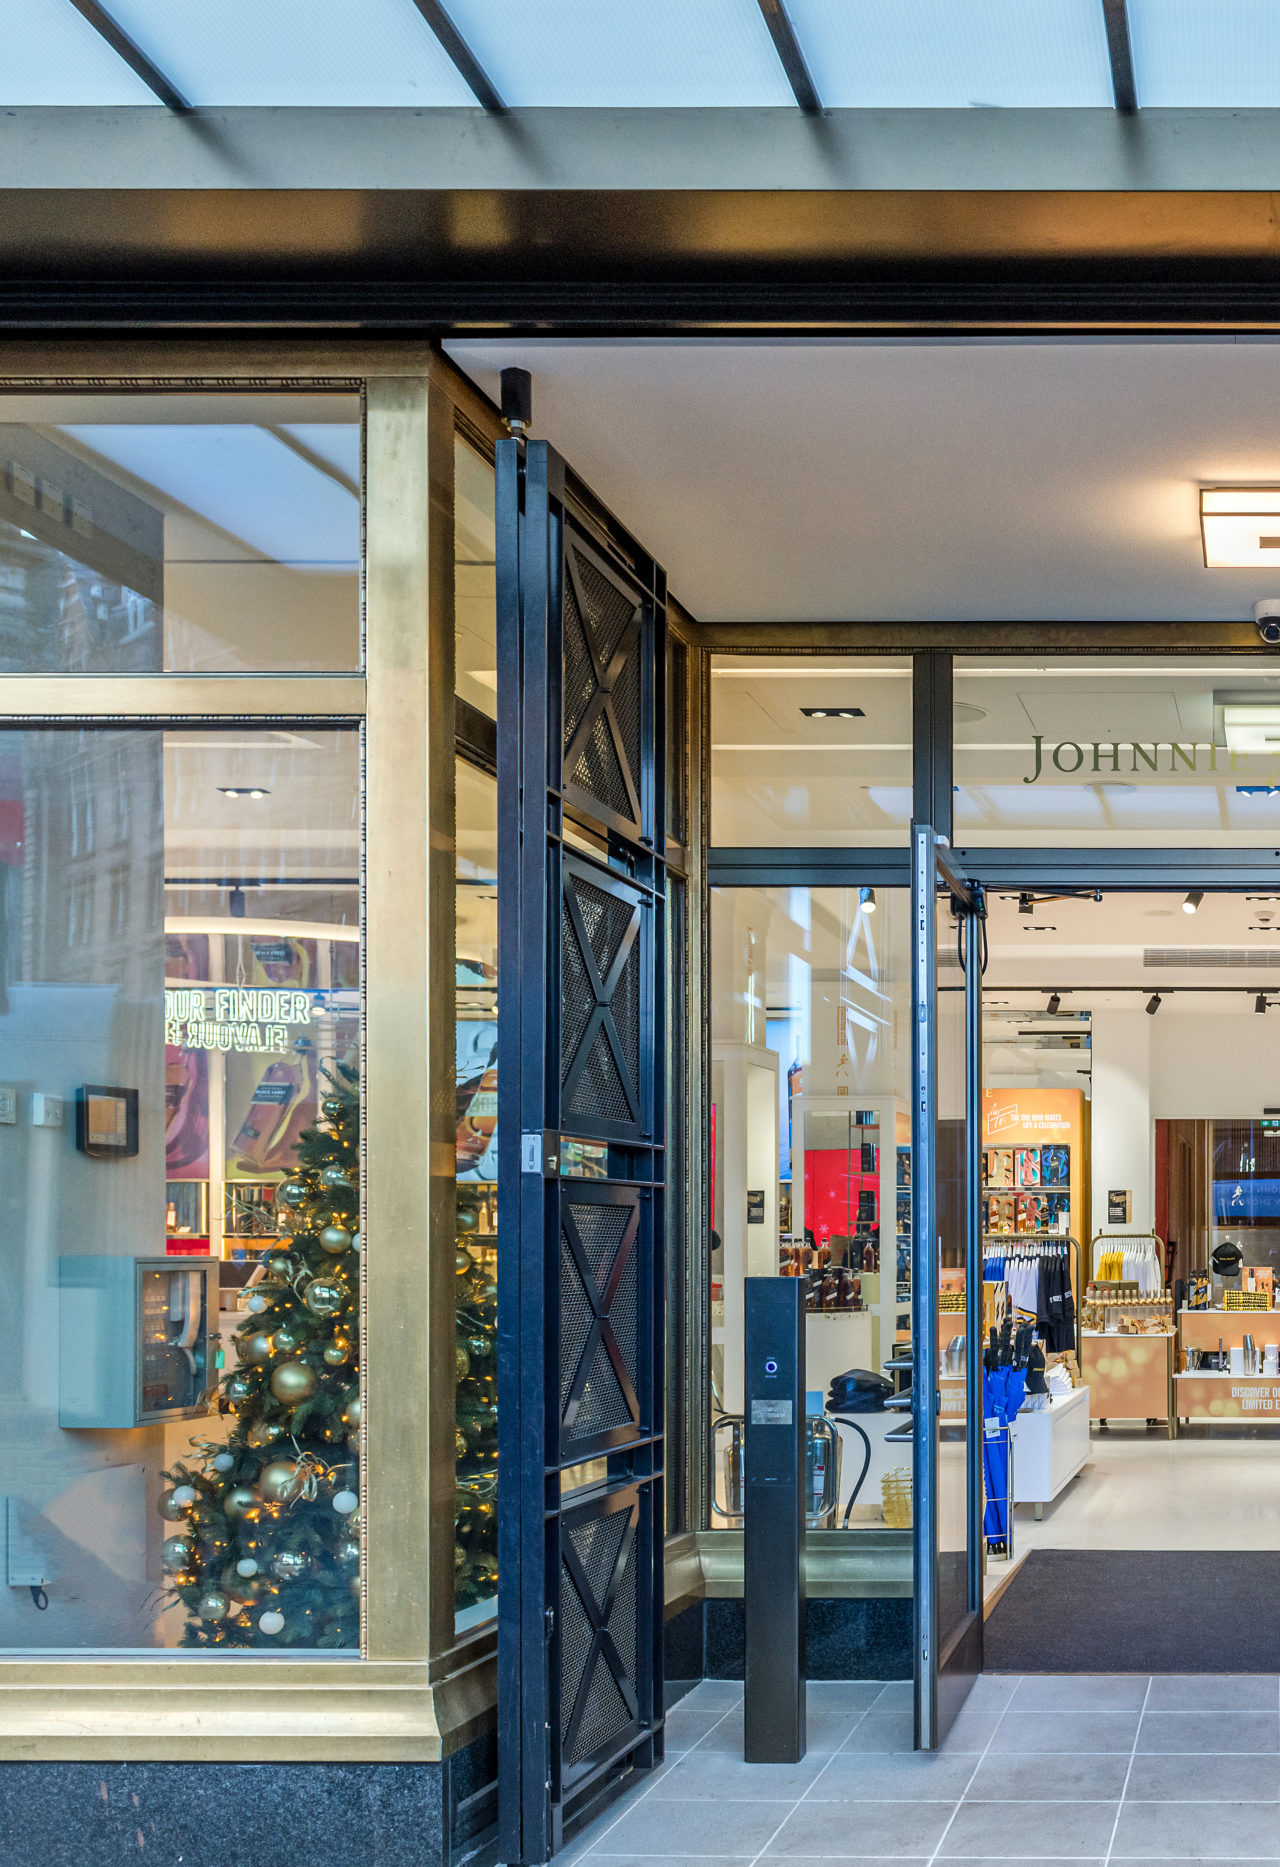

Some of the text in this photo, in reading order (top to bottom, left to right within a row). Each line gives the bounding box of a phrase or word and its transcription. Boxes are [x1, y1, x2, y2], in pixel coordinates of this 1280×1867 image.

[1023, 735, 1251, 783] JOHNNIE
[214, 989, 311, 1024] FINDER
[1231, 1387, 1270, 1398] DISCOVER
[1241, 1399, 1273, 1410] LIMITED
